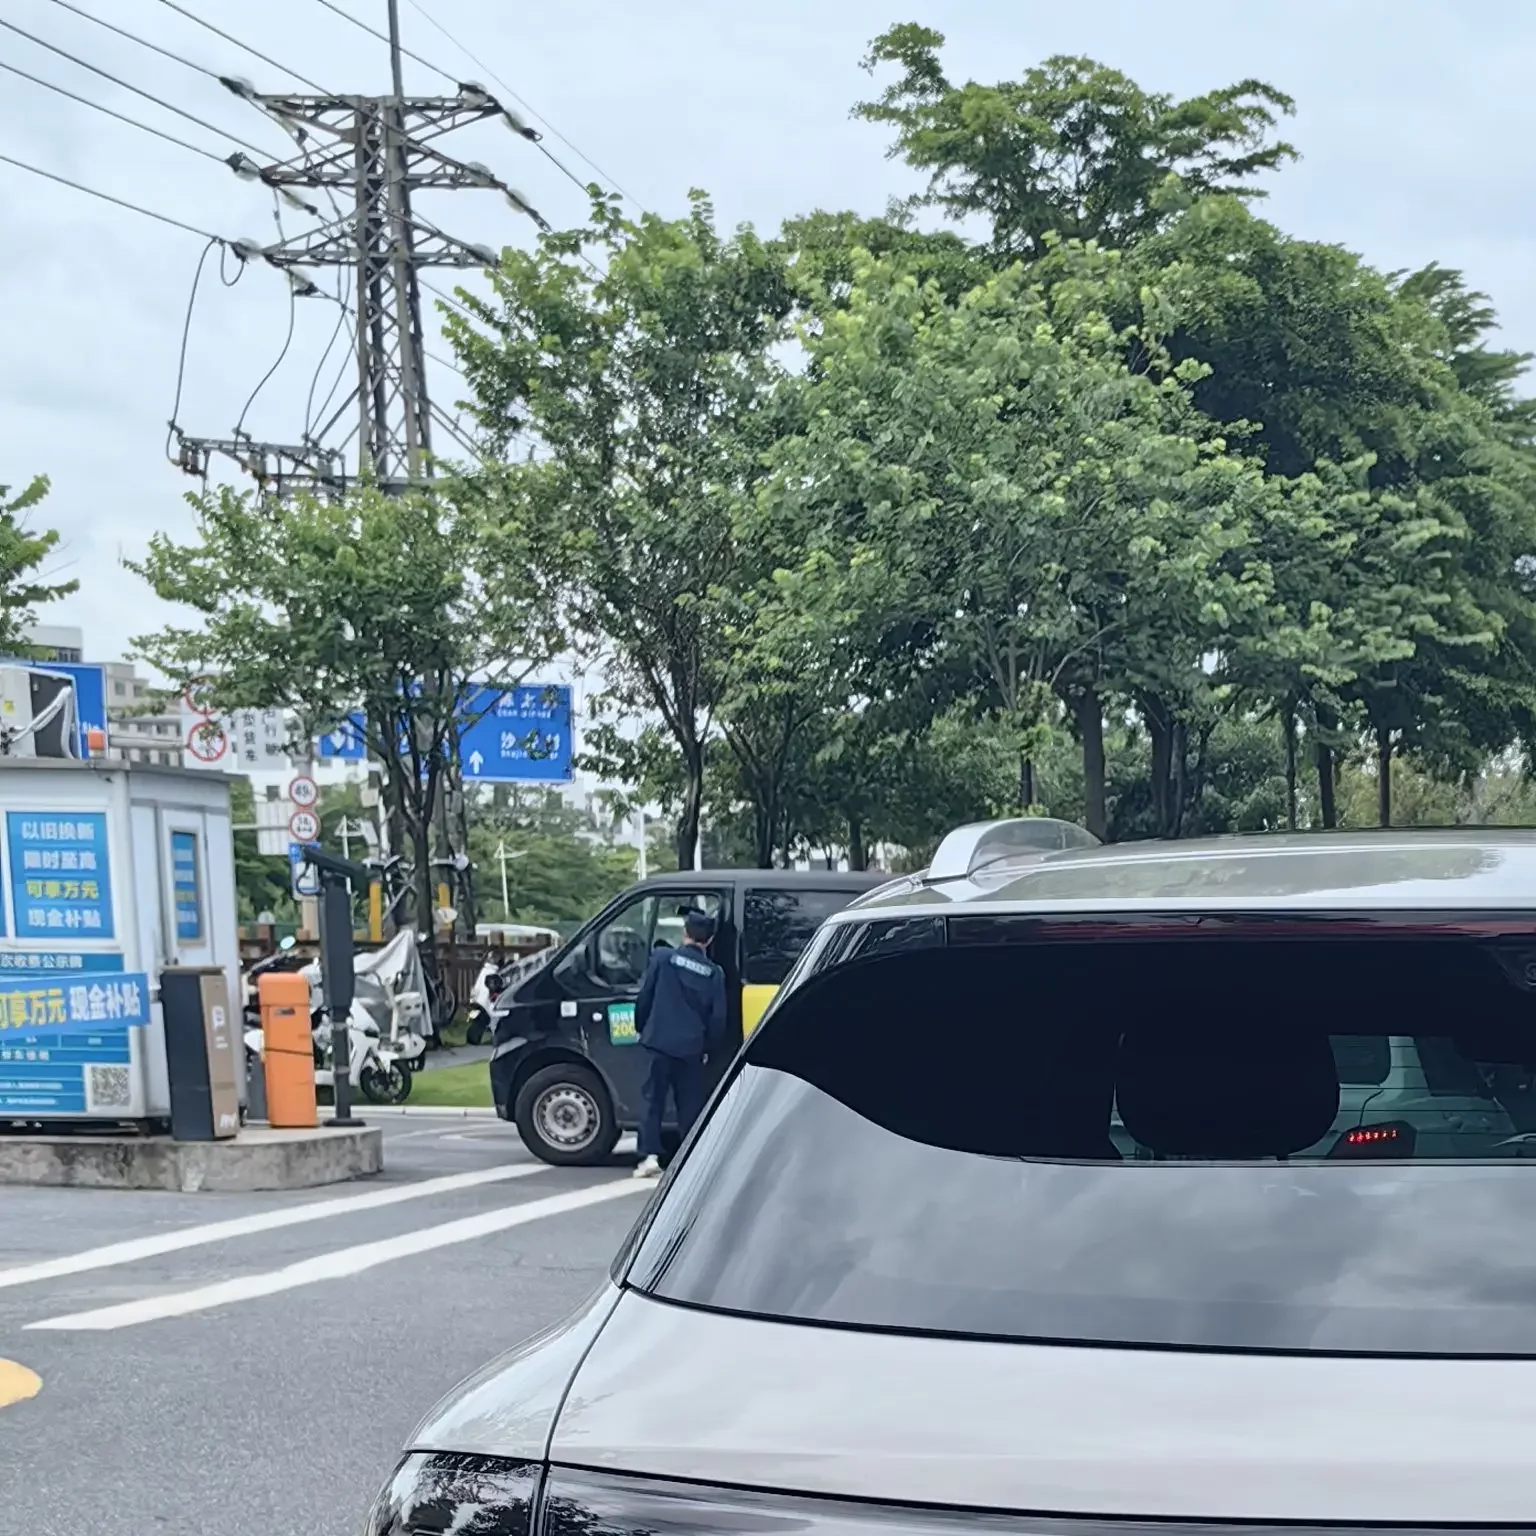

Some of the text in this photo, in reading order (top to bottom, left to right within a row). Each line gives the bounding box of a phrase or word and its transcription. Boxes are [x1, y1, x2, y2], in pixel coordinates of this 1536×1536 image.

[22, 821, 95, 841] 以旧换新
[26, 879, 100, 900] 可享万元
[28, 908, 101, 929] 现金补贴
[69, 981, 141, 1021] 现金补贴
